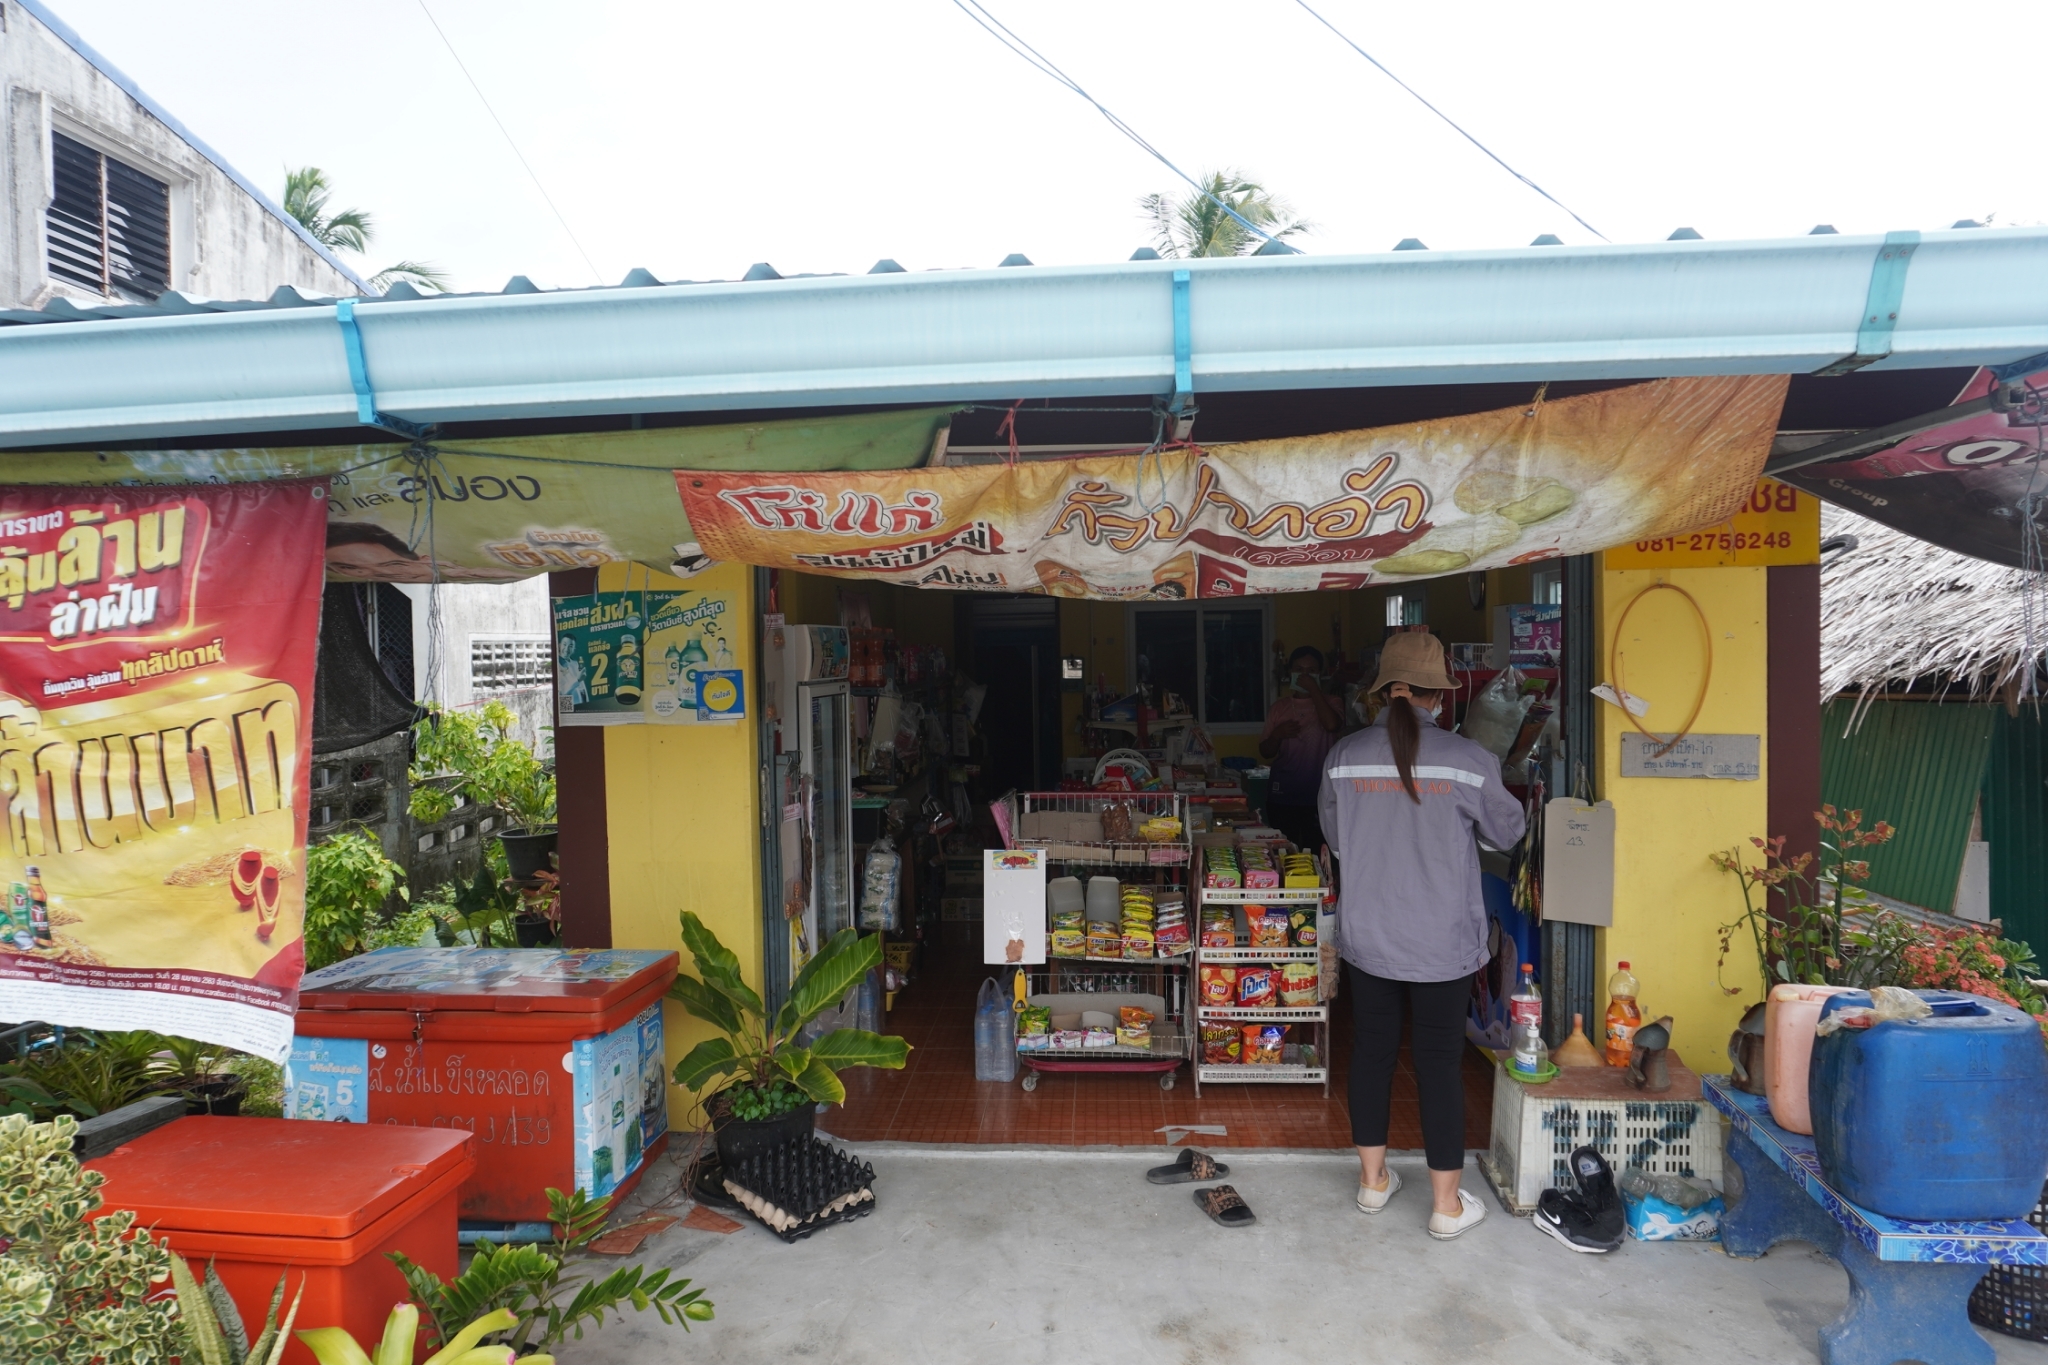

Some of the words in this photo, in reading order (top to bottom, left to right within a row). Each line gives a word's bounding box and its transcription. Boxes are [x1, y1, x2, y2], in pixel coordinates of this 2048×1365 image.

[396, 475, 542, 503] สมอง
[1828, 479, 1890, 507] Group
[0, 511, 63, 538] าราบาว
[535, 529, 600, 543] วิตามิน
[1231, 544, 1374, 566] เคลือบ
[1636, 531, 1792, 552] 081-2756248
[49, 583, 160, 639] ล่าฝัน
[121, 639, 224, 685] ทุกสัปดาห์
[591, 653, 608, 686] 2
[591, 684, 609, 696] บาท
[369, 1045, 550, 1096] ส.น้ำแข็งหลอด
[336, 1079, 353, 1106] 5
